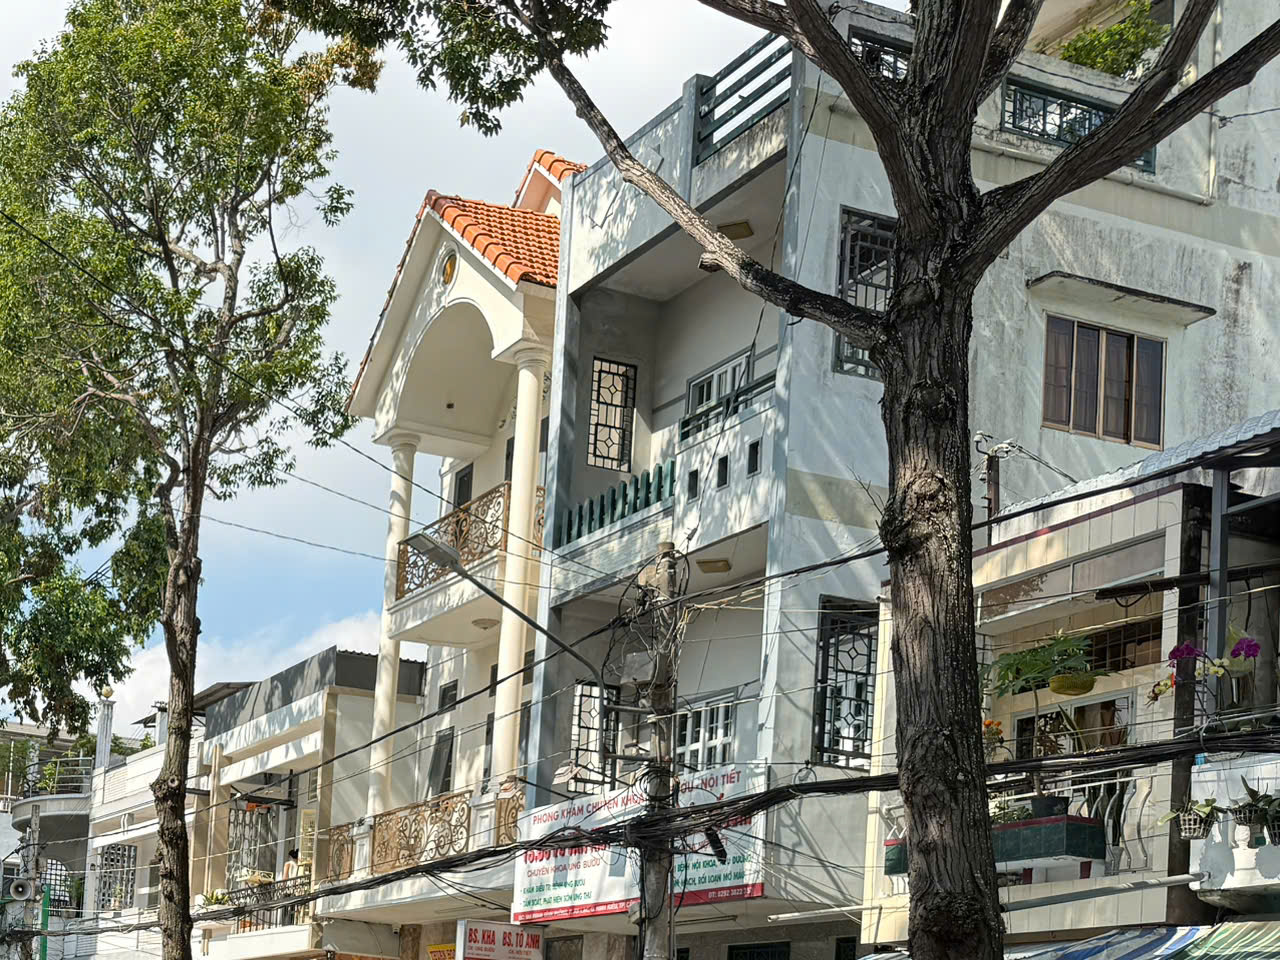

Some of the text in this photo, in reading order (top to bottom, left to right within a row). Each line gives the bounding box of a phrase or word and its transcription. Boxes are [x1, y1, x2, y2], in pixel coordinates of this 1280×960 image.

[701, 777, 718, 792] NỘI
[721, 769, 741, 786] TIẾT
[468, 928, 496, 945] BS. KHA
[503, 931, 513, 947] BS.
[526, 932, 540, 949] ANH
